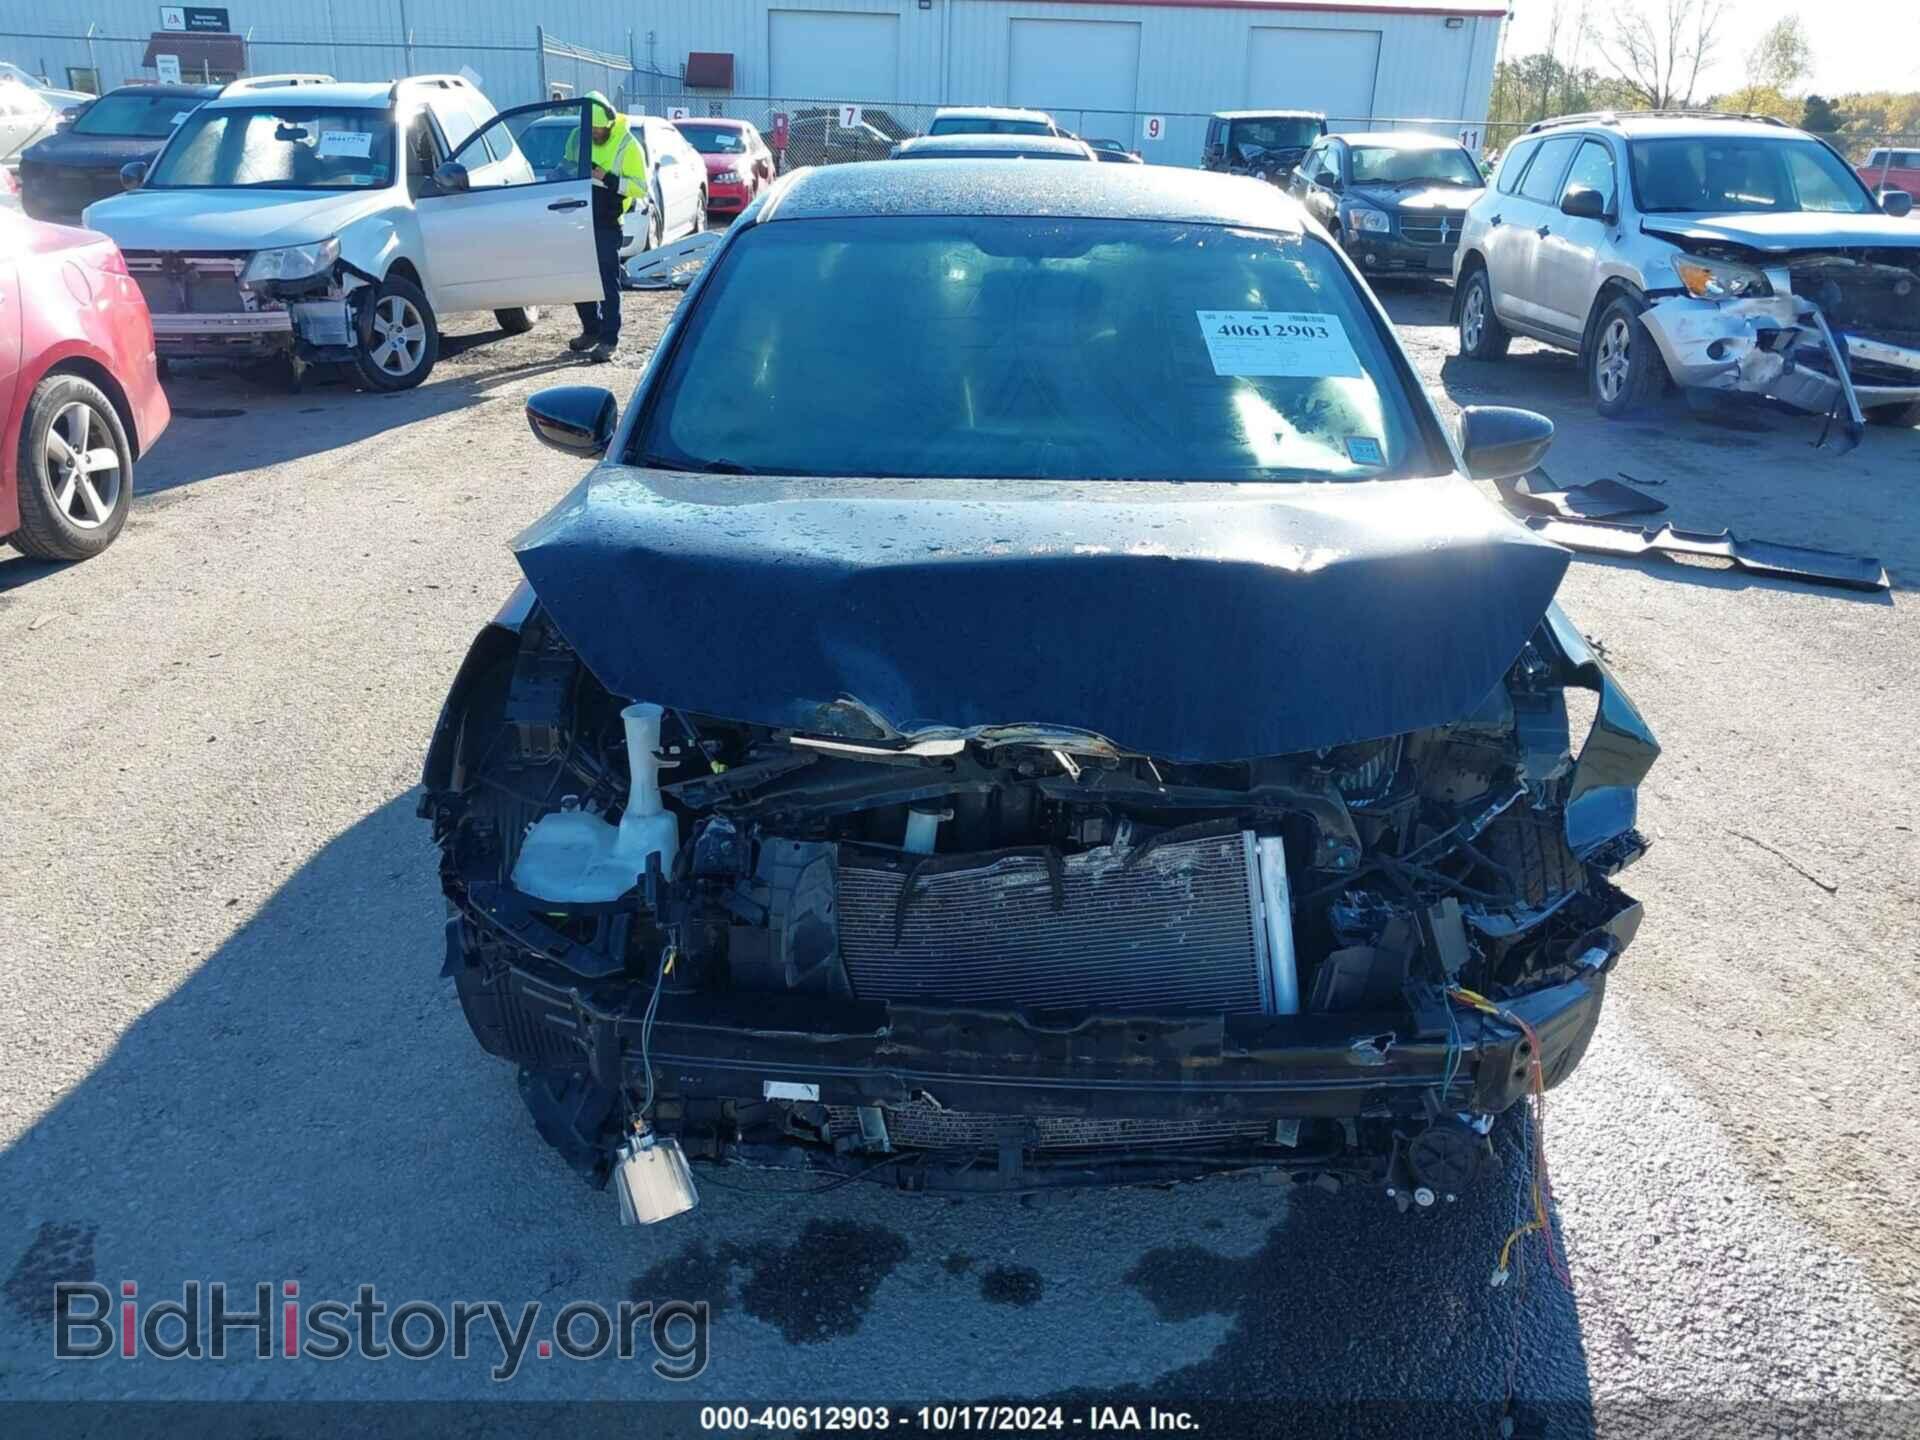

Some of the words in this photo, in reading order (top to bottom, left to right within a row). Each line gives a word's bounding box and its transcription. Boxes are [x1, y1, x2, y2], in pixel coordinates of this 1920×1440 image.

[846, 107, 855, 126] 7
[1149, 118, 1159, 138] 9
[1460, 130, 1478, 150] 11
[1217, 324, 1329, 339] 40612903
